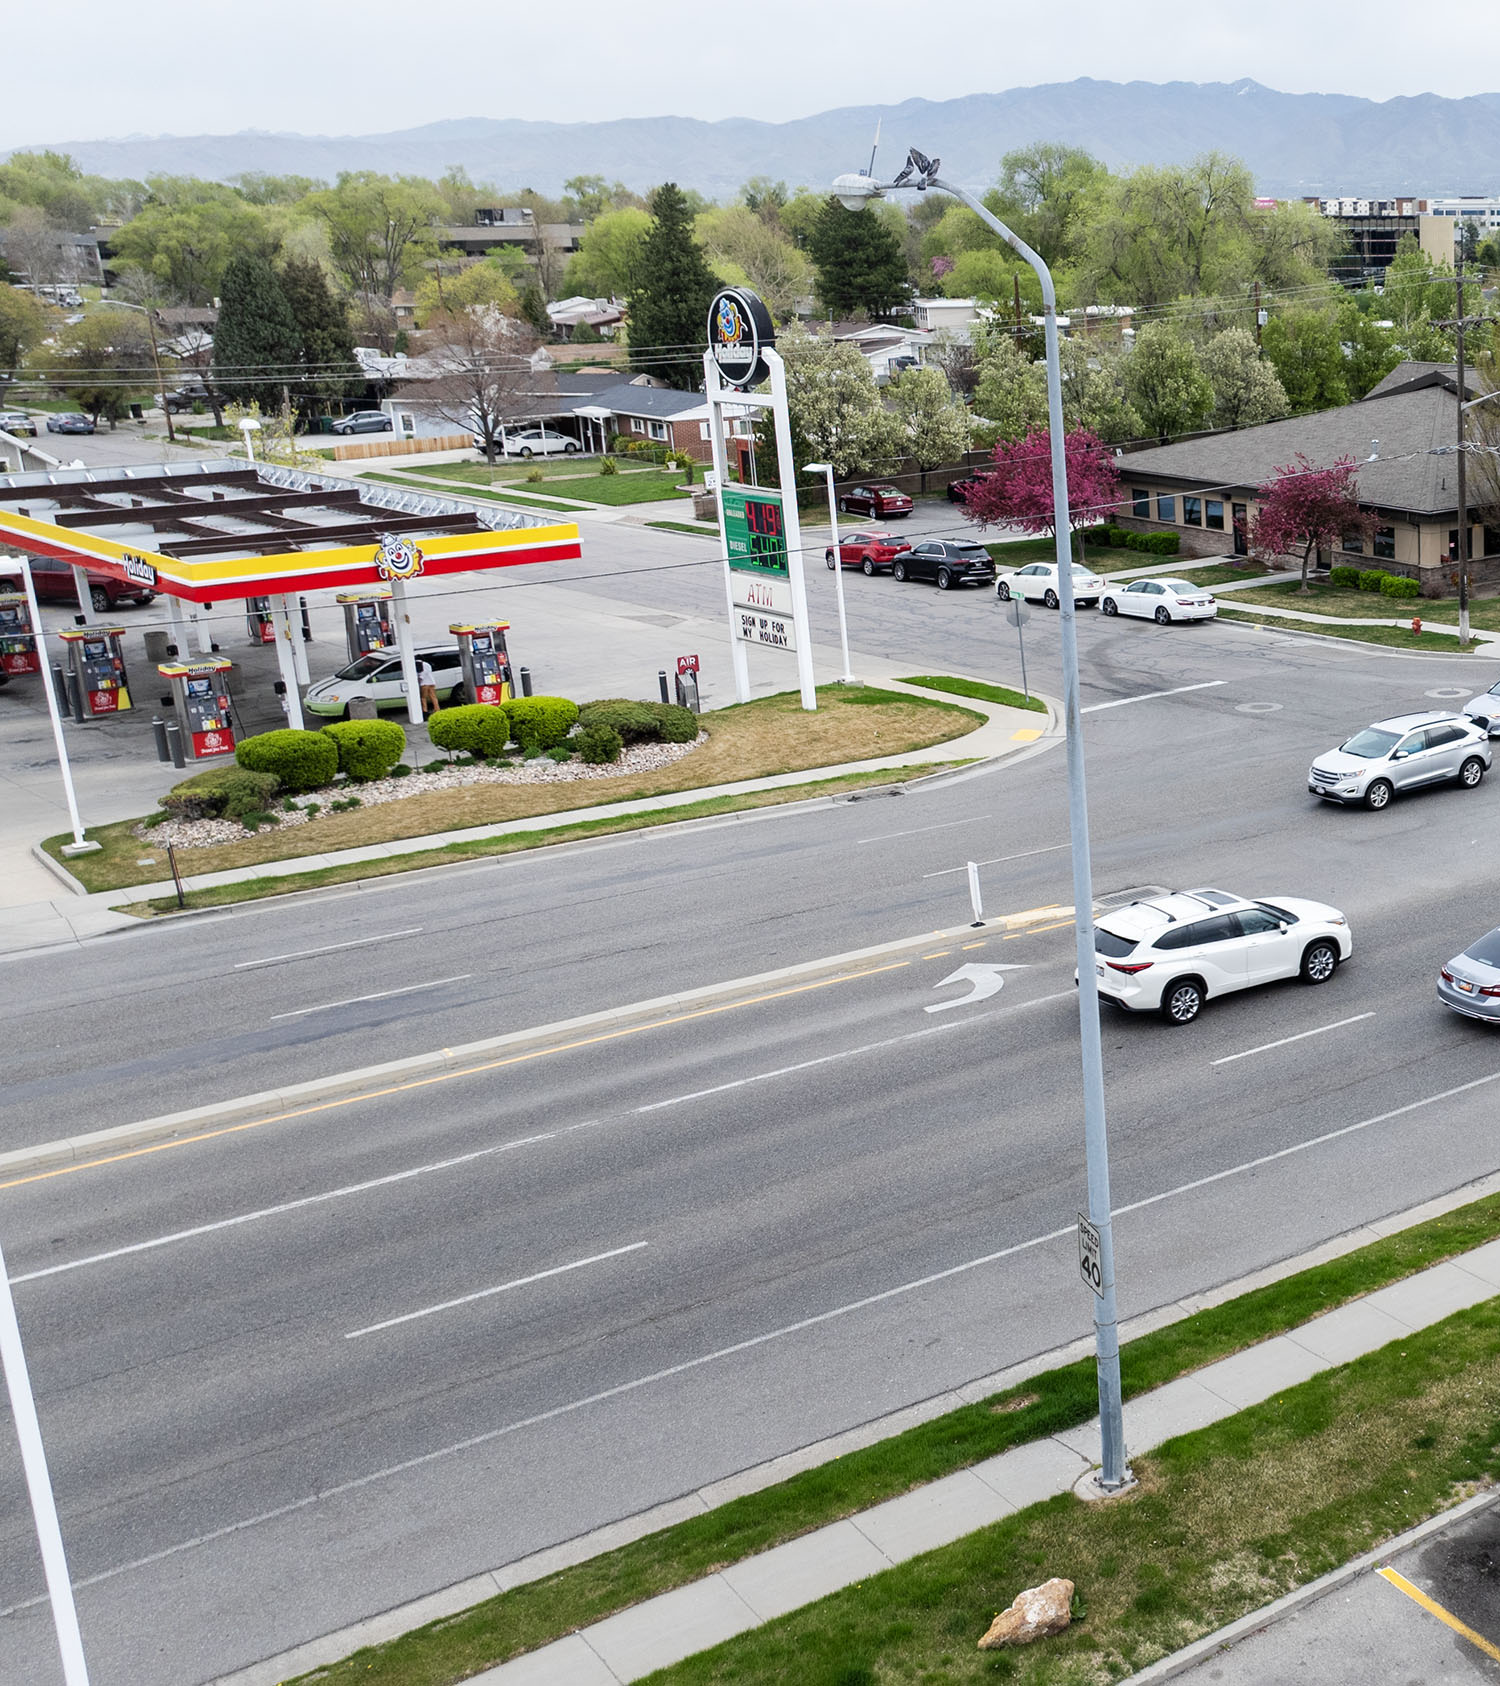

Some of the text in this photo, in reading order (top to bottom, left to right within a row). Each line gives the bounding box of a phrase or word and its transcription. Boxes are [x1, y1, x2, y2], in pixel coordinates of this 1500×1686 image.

[729, 540, 748, 552] DIESEL
[122, 553, 155, 585] Holiday
[747, 583, 773, 607] ATM
[741, 614, 785, 634] SIGN UP FOR
[742, 627, 788, 646] MY HOLIDAY
[188, 665, 216, 674] Holiday
[680, 657, 696, 667] AIR
[1080, 1222, 1098, 1248] SPEED
[1082, 1239, 1097, 1259] LIMIT
[1082, 1255, 1101, 1288] 40
